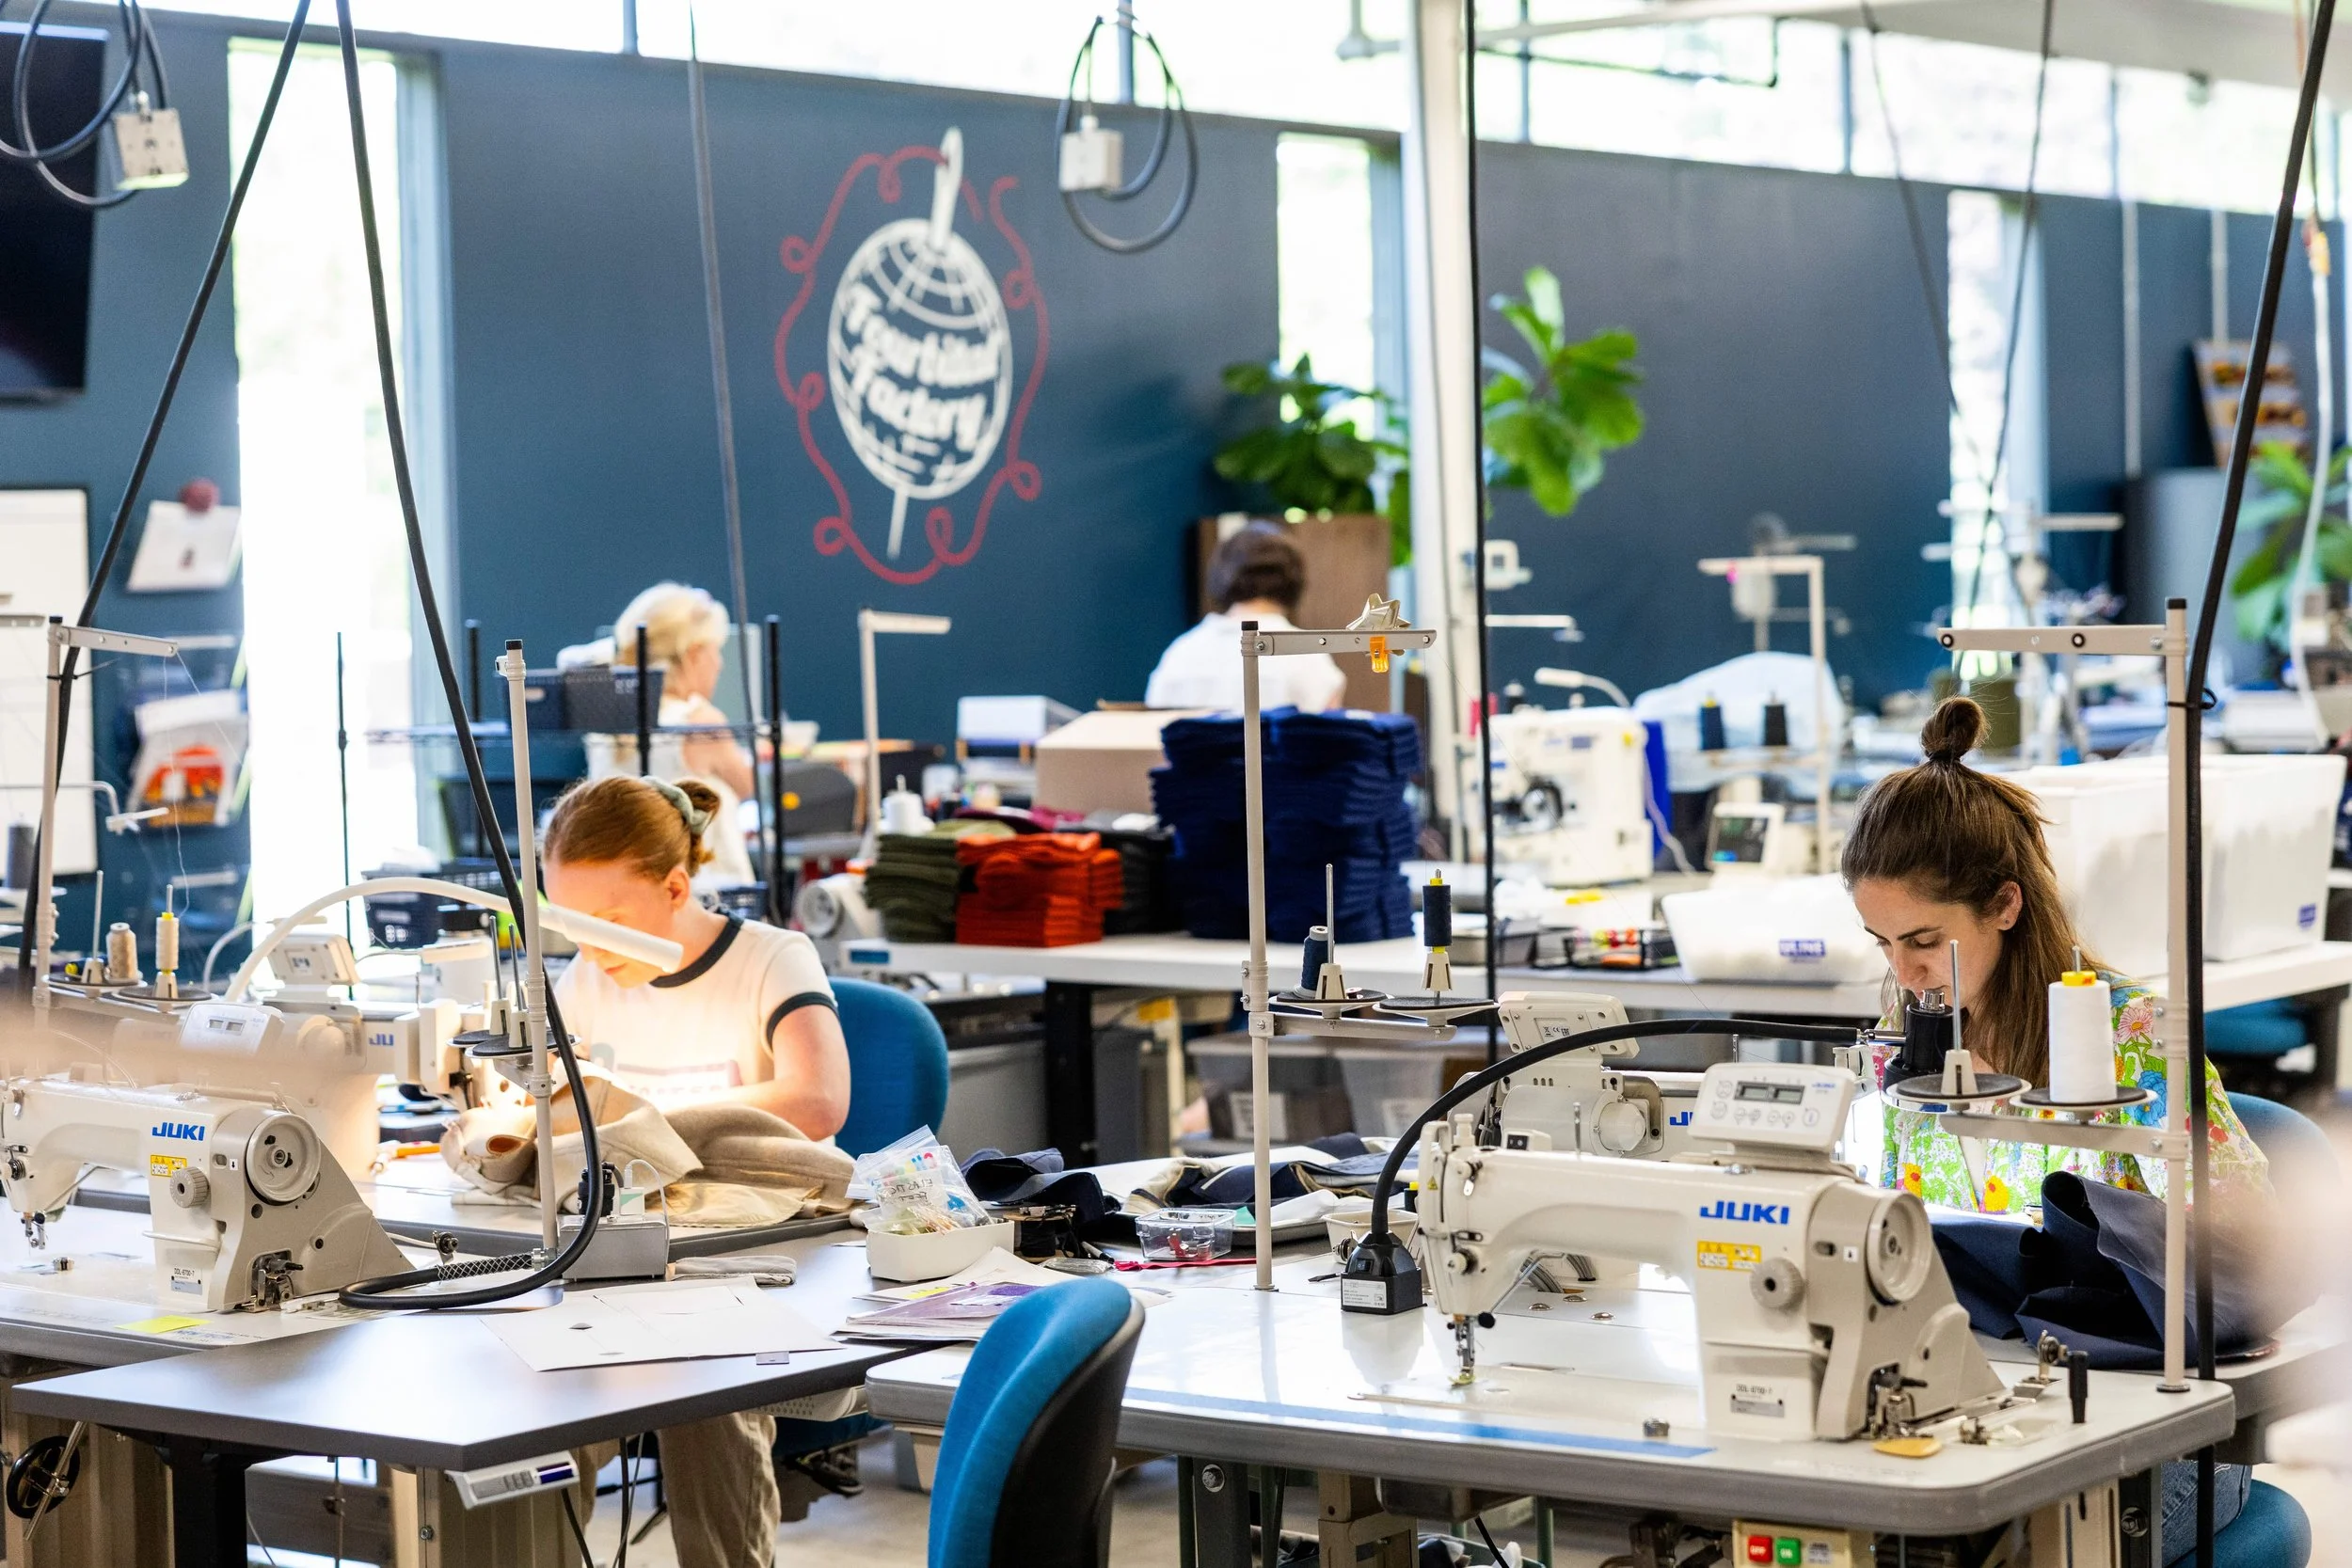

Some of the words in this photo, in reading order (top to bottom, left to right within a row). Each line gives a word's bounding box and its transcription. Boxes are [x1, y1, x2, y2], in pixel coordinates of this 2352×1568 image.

[368, 1033, 394, 1046] JU
[151, 1121, 205, 1141] JUKI
[1699, 1200, 1789, 1225] JUKI
